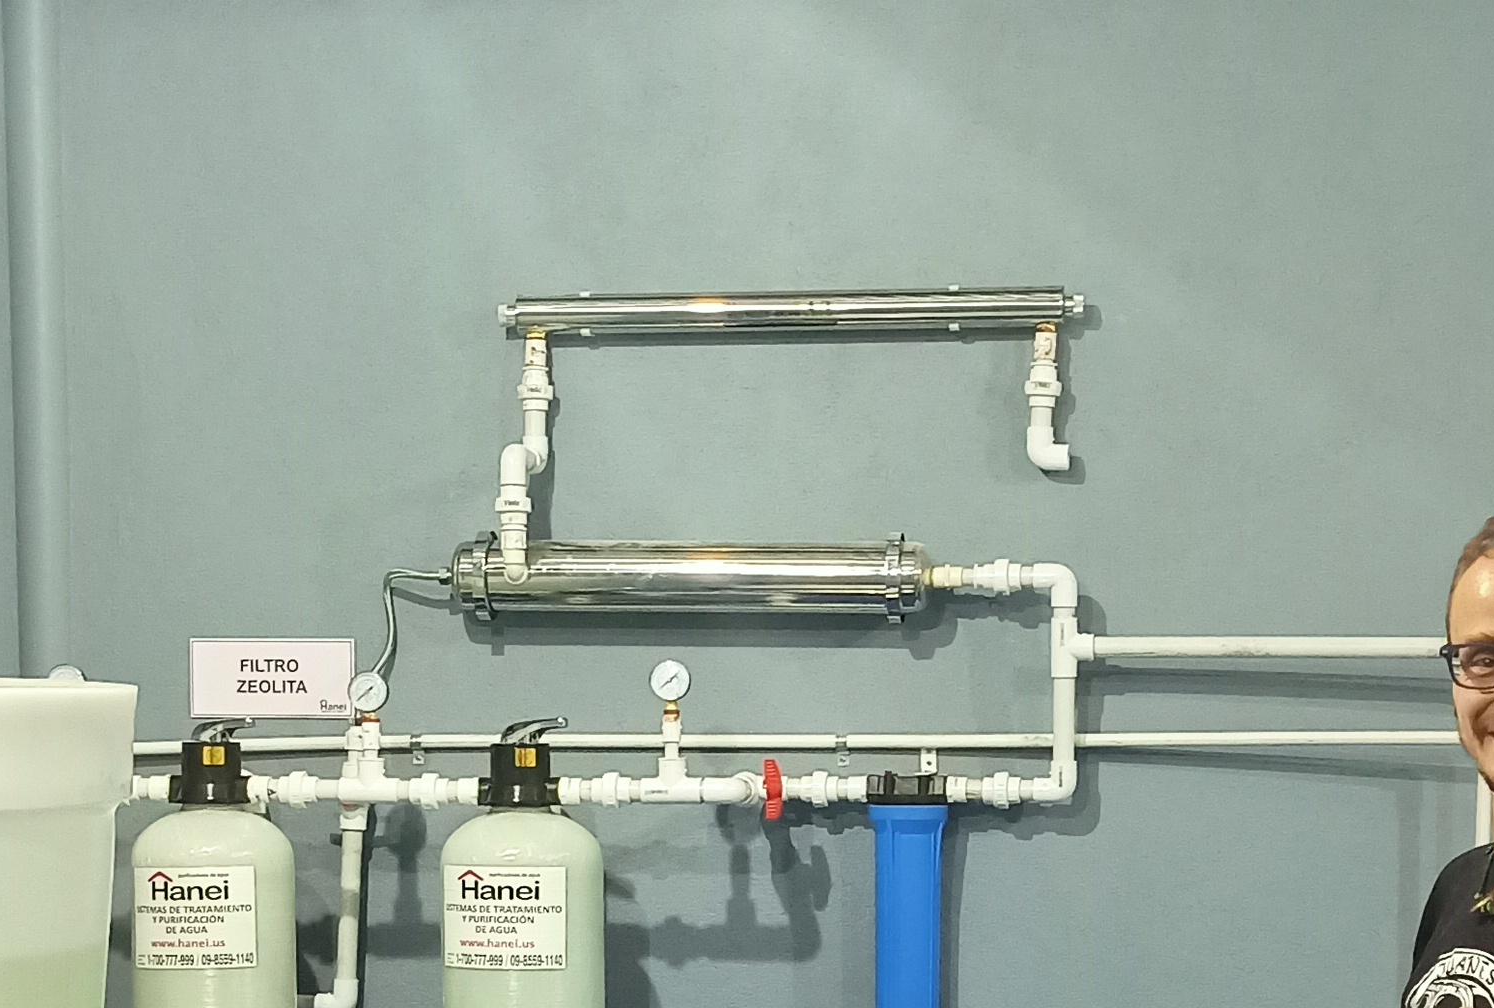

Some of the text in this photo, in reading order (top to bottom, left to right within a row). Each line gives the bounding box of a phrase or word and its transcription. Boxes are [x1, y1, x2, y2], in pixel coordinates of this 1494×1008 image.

[240, 659, 299, 673] FILTRO
[236, 680, 308, 694] ZEOLITA
[320, 700, 347, 711] Hanei
[151, 880, 229, 901] Hanei
[461, 879, 540, 900] Hanei
[169, 906, 181, 914] DE
[184, 904, 252, 913] TRATAMIENTO
[479, 905, 491, 913] DE
[494, 905, 562, 914] TRATAMIENTO
[152, 914, 224, 923] Y PURIFICACIÓN
[462, 914, 535, 924] Y PURIFICACIÓN
[166, 926, 208, 934] DE AGUA
[475, 925, 518, 934] DE AGUA
[151, 939, 226, 948] www.hanei.us
[460, 939, 535, 948] www.hanei.us
